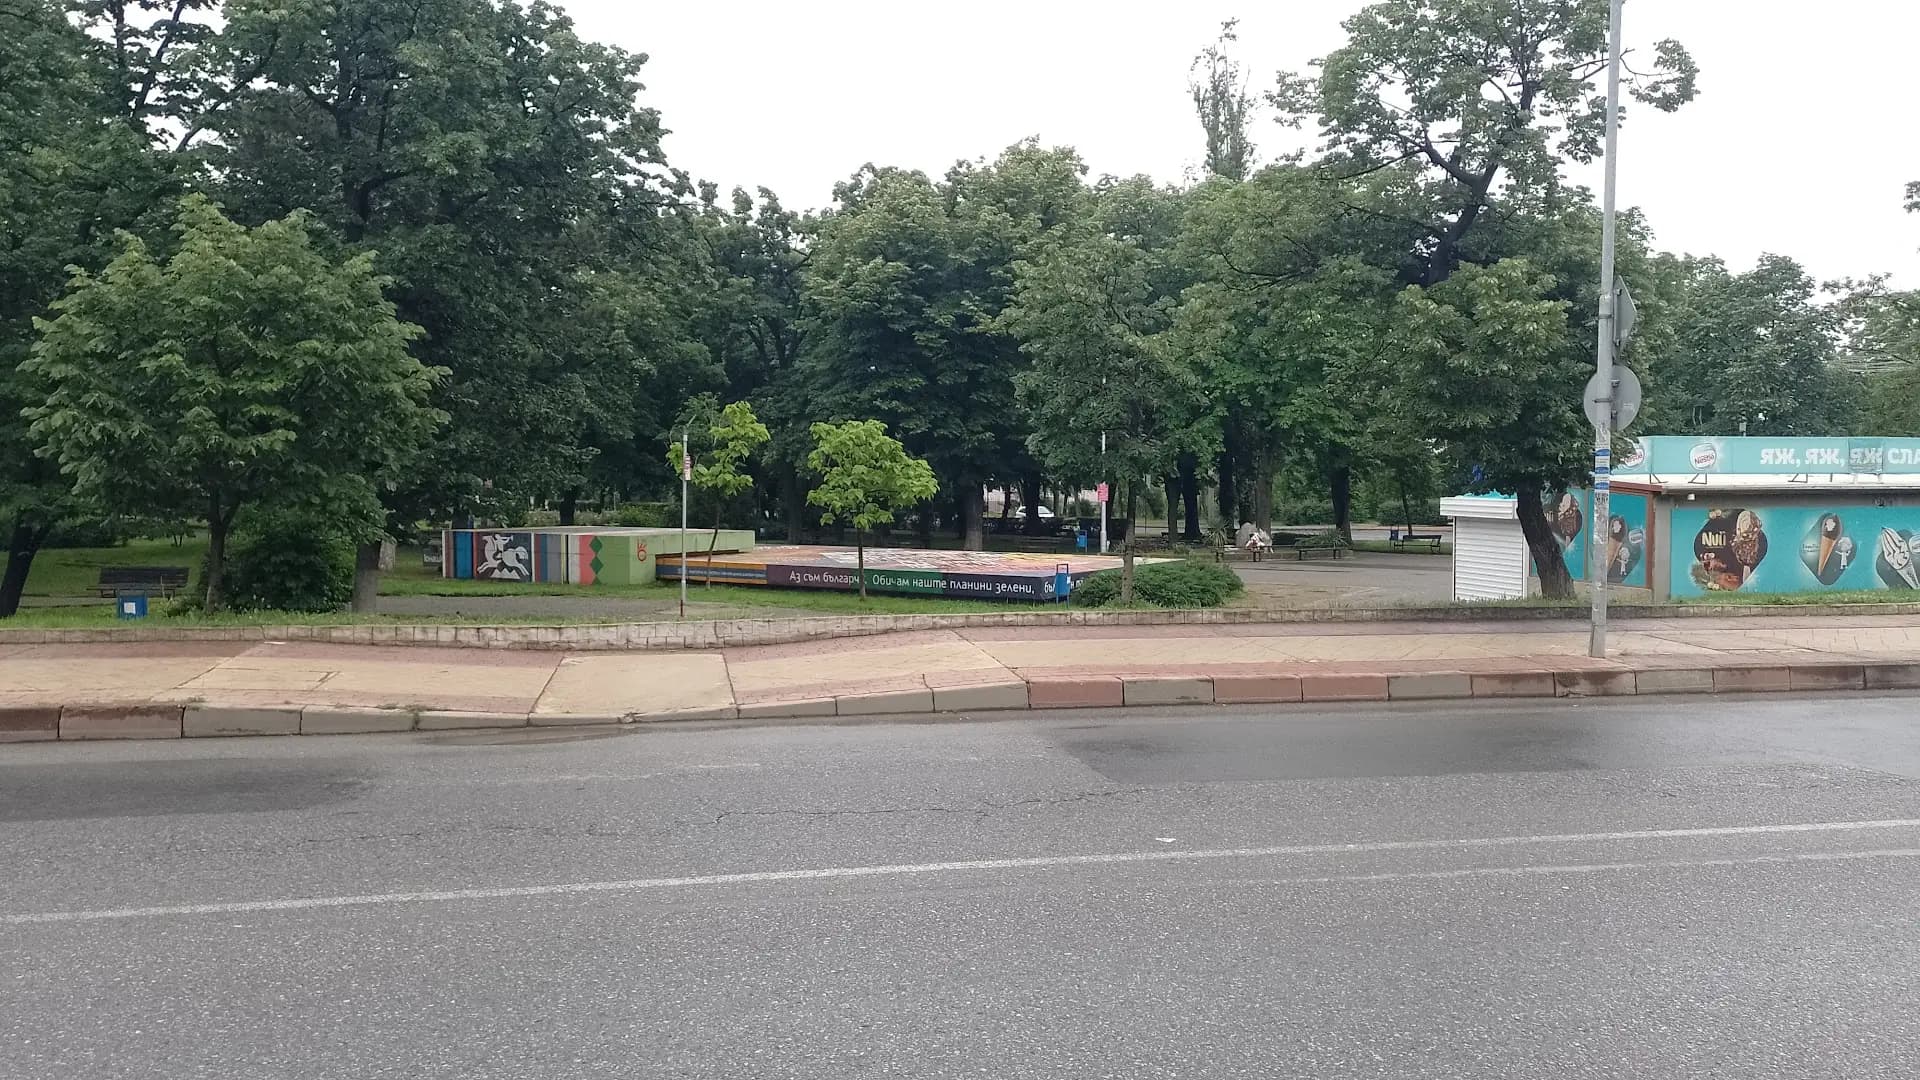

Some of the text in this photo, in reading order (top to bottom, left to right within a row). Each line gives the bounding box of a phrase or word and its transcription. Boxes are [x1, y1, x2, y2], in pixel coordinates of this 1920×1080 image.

[1760, 448, 1801, 467] ЯЖ,
[1805, 448, 1845, 467] ЯЖ,
[789, 570, 801, 583] Аз
[803, 572, 820, 583] съм
[912, 578, 947, 589] наште
[950, 580, 992, 591] планини
[995, 582, 1035, 594] зелени,
